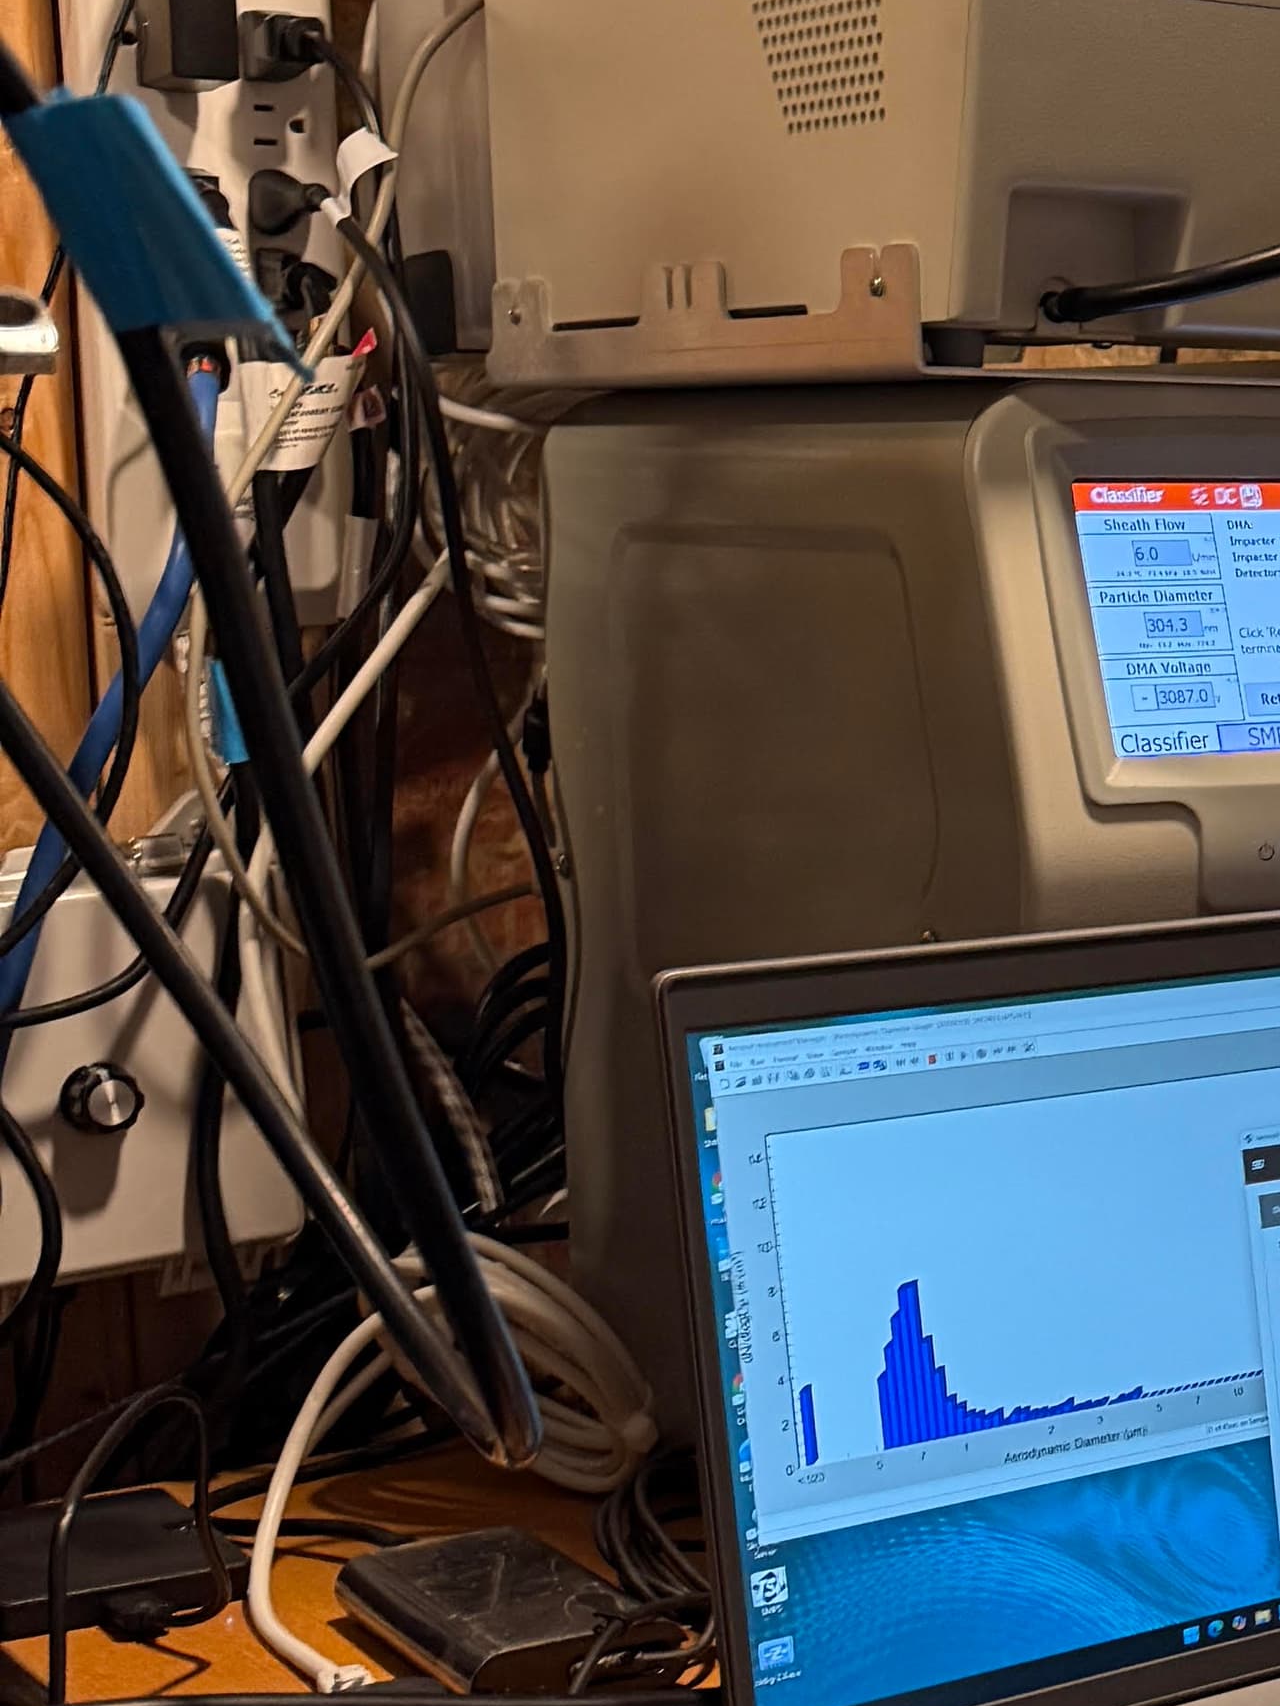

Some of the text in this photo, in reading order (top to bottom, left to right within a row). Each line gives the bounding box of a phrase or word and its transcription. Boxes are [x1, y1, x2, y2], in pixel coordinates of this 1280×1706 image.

[1090, 487, 1164, 505] Classifier
[1103, 518, 1186, 532] Sheath Flow
[1230, 535, 1276, 548] Impactor
[1134, 545, 1160, 562] 6.0
[1233, 551, 1279, 564] Impactor
[1099, 589, 1214, 605] Particle Diameter
[1146, 616, 1189, 635] 304.3
[1239, 626, 1264, 639] Click
[1126, 660, 1213, 677] DMA Voltage
[1158, 688, 1209, 706] 3087.0
[1120, 730, 1209, 755] Classifier
[1004, 1429, 1121, 1465] Aerodynamic Diameter
